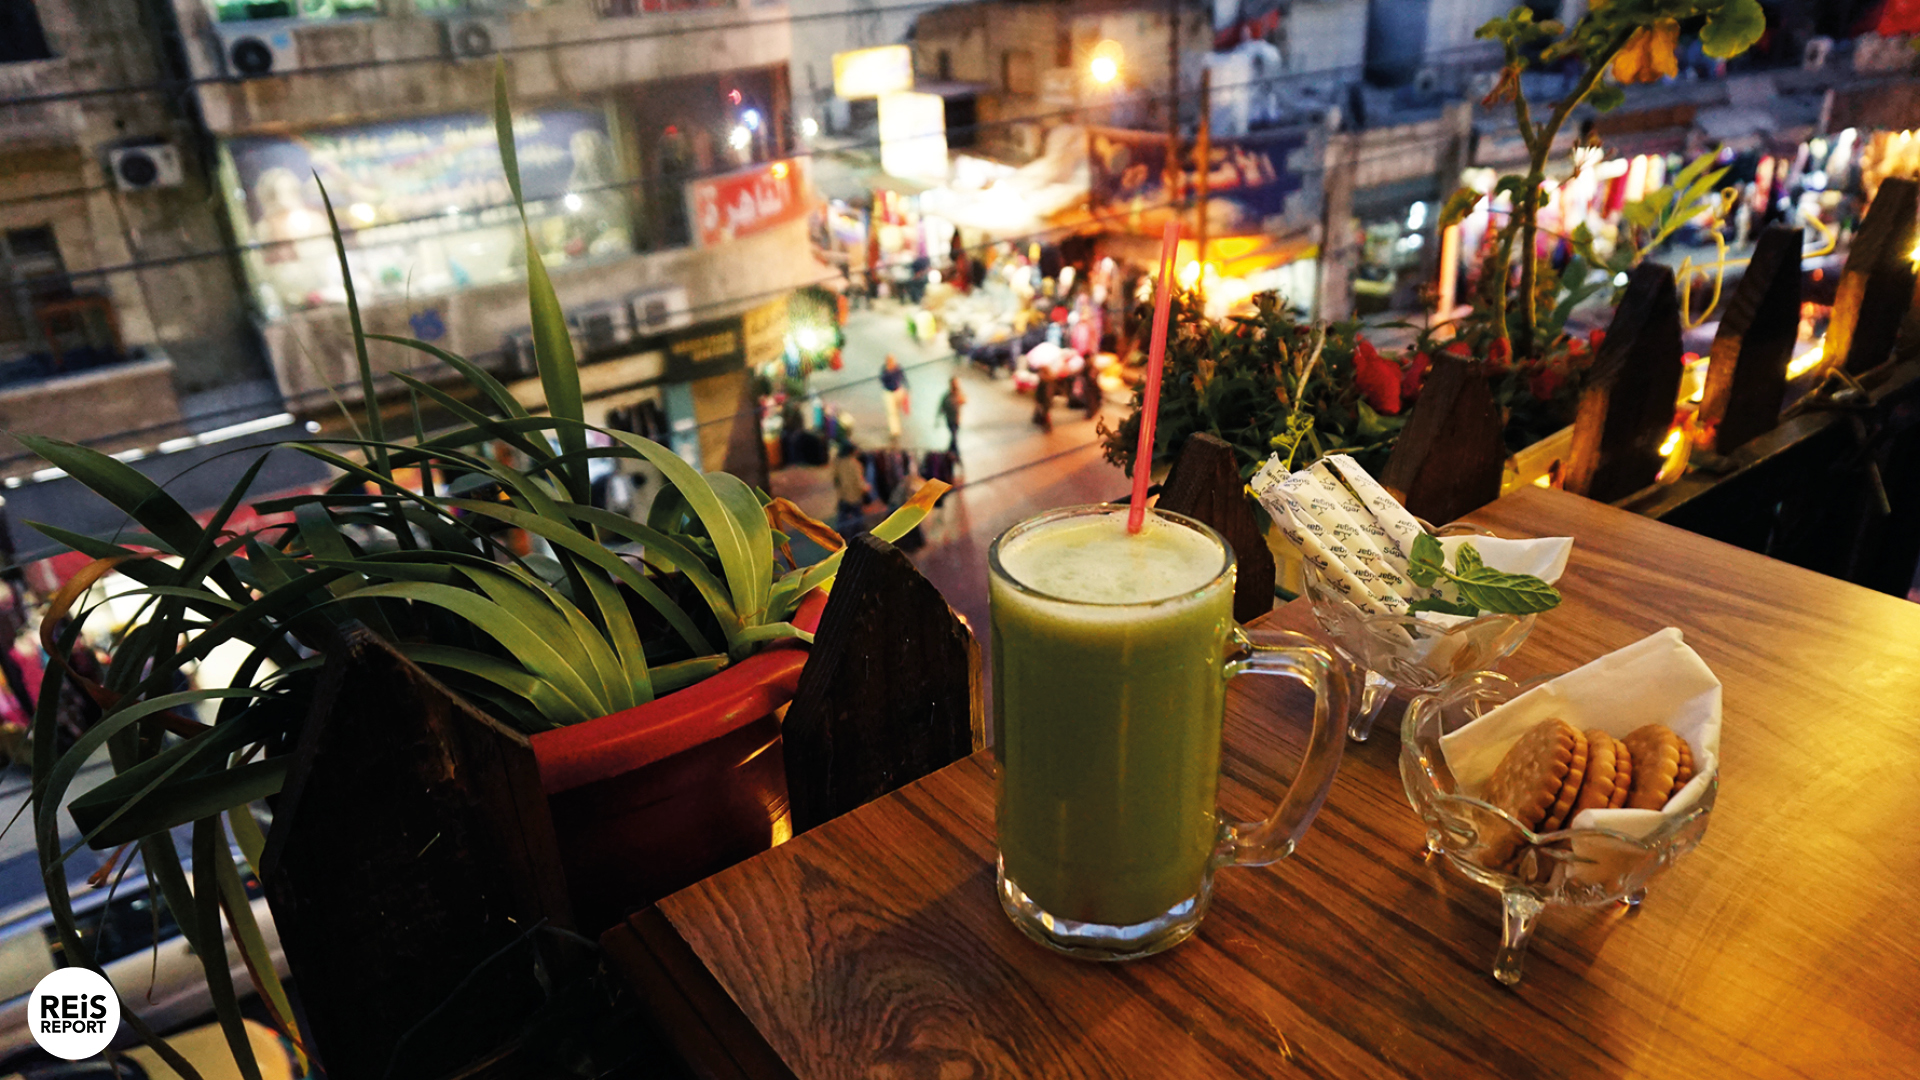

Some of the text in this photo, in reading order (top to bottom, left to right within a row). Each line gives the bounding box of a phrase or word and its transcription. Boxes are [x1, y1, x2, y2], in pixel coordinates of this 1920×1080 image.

[1335, 523, 1360, 536] Sugar
[1383, 547, 1401, 558] Sug
[1378, 572, 1403, 585] Sugar
